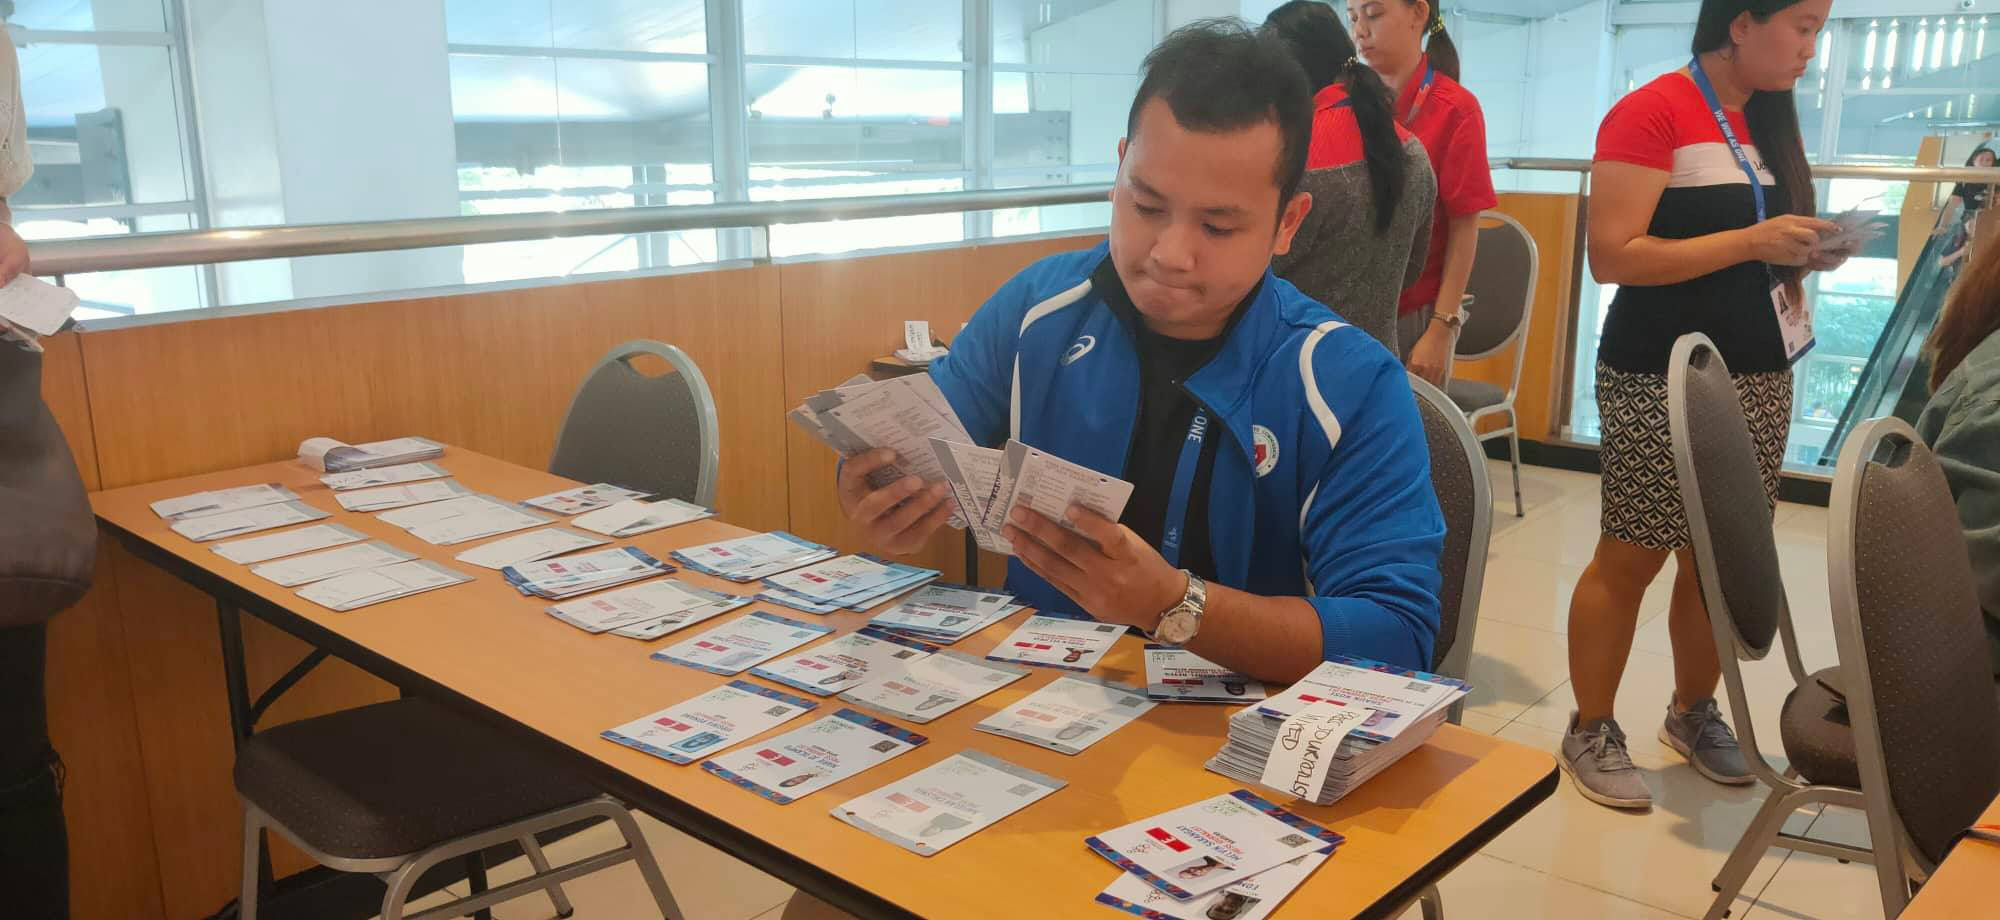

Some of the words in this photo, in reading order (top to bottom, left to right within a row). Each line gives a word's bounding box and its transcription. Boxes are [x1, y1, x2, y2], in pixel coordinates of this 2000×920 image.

[1714, 109, 1728, 123] WE
[1720, 120, 1736, 138] WIN
[1728, 136, 1740, 148] AS
[1187, 415, 1208, 443] ONE
